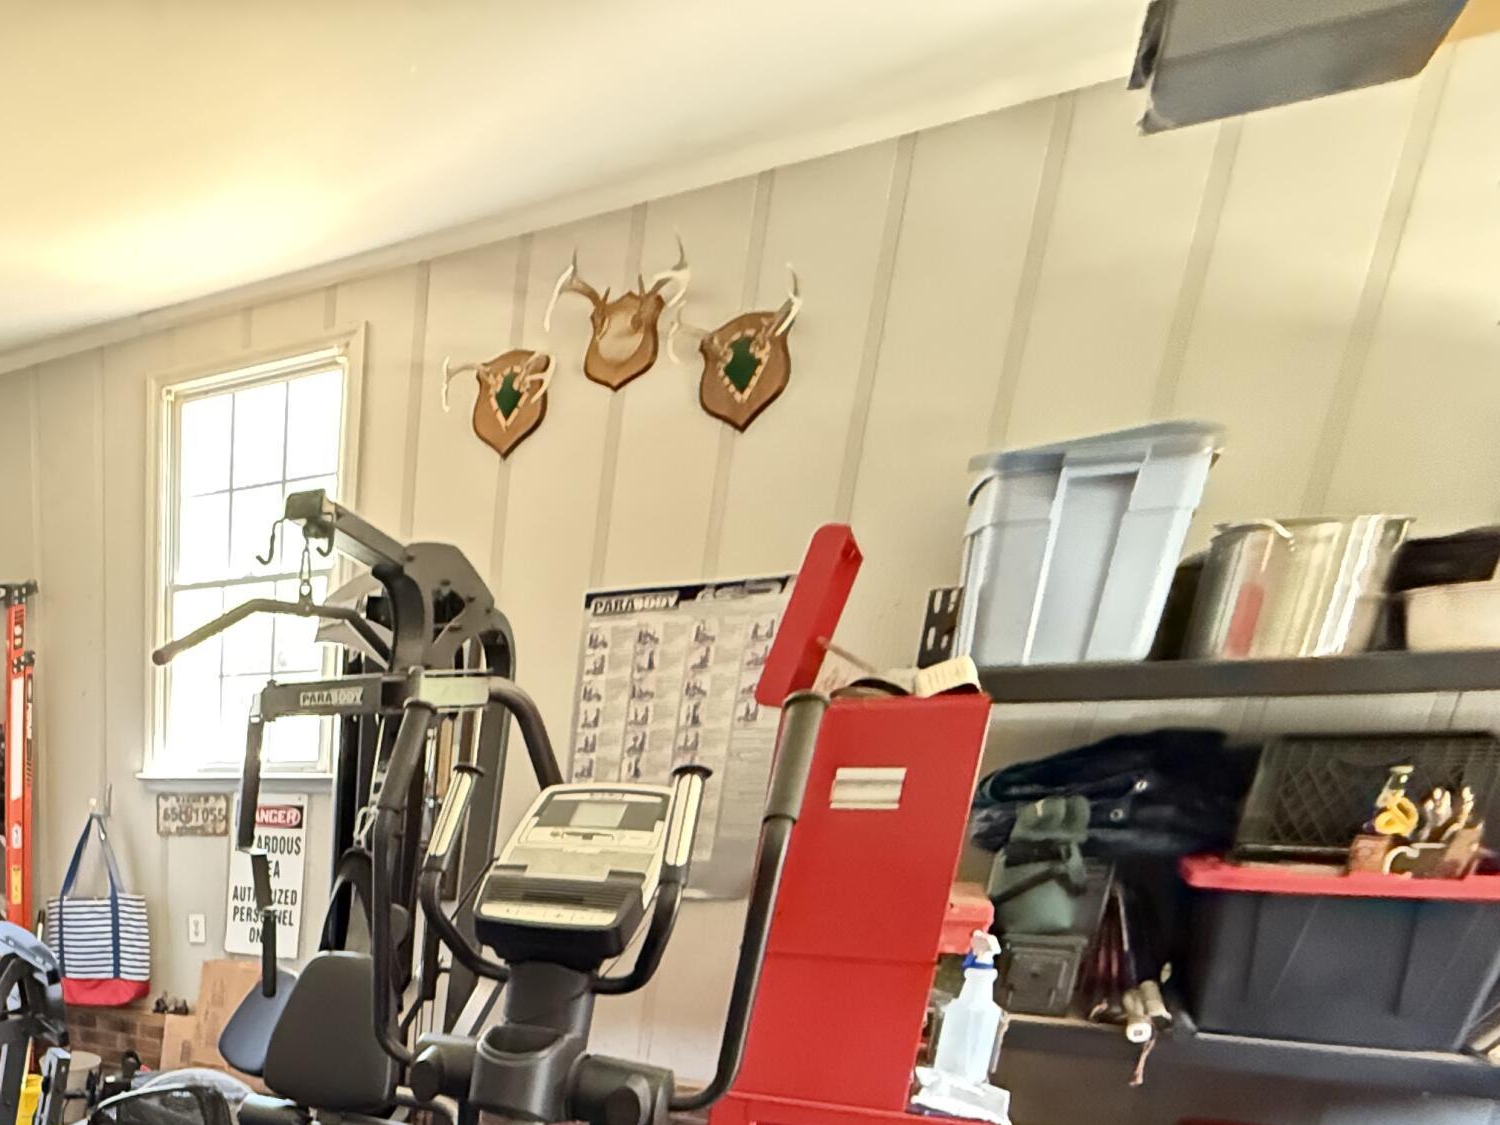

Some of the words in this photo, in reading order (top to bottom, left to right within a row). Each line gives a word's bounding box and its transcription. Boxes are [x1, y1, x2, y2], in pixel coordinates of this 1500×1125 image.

[256, 807, 298, 825] NGER
[257, 834, 302, 856] ARDOUS
[232, 885, 298, 907] AUTIZED
[232, 905, 294, 927] PERSNEL
[249, 926, 261, 943] ON
